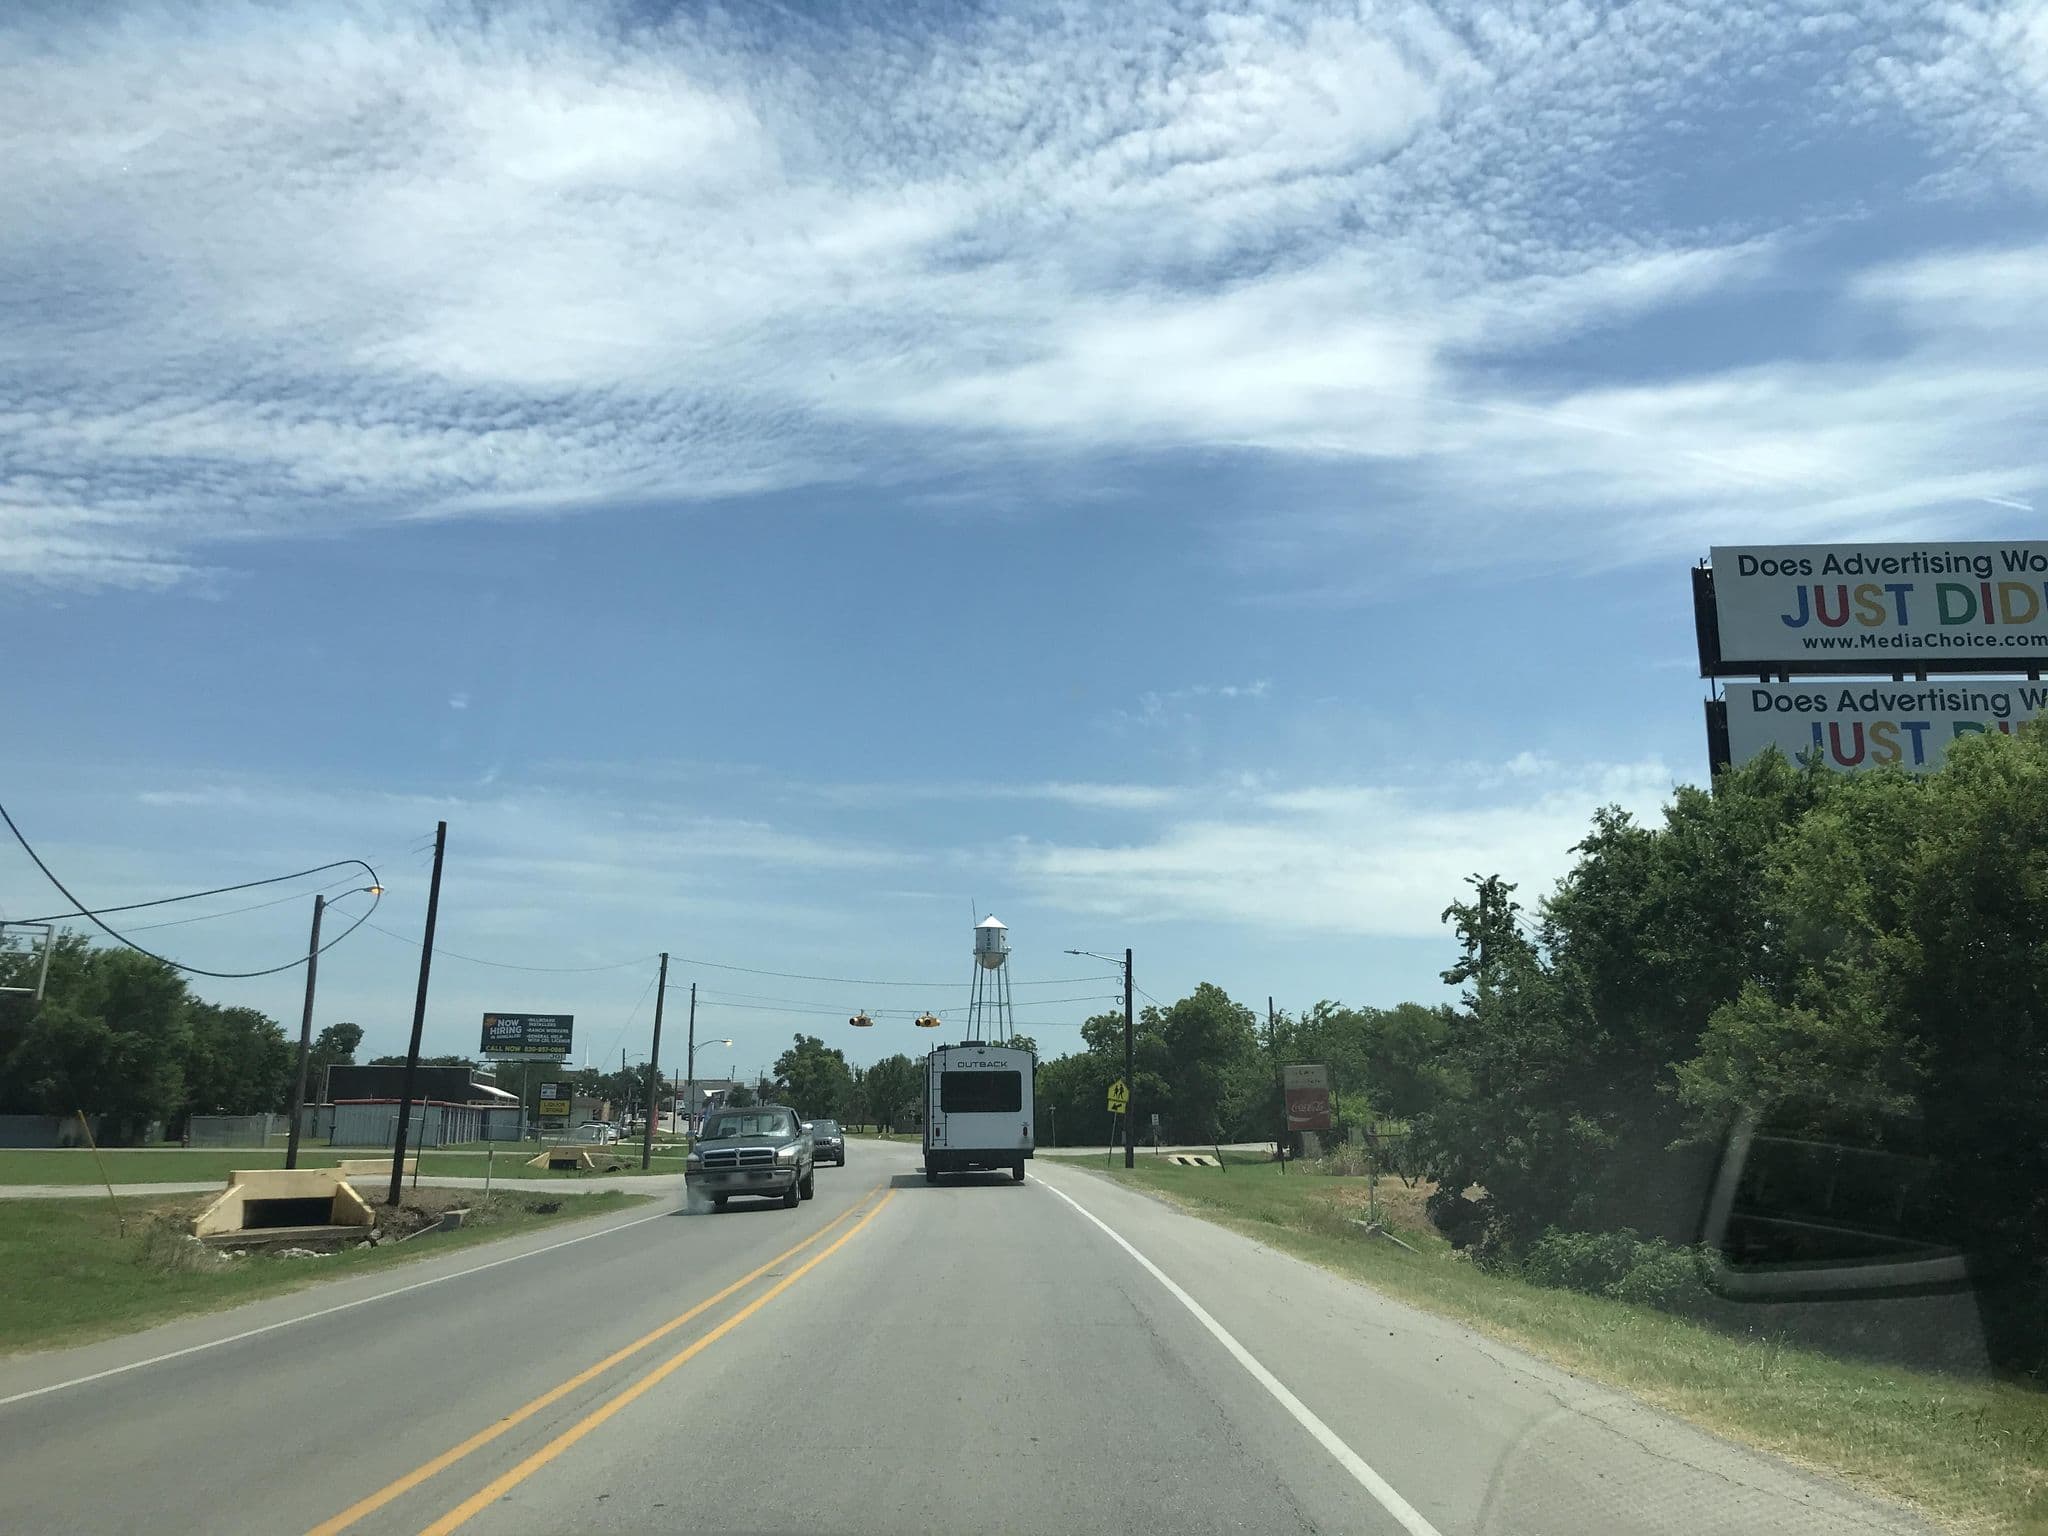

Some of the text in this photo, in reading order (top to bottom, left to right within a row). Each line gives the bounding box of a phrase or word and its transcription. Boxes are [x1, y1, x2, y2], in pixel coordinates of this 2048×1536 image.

[1738, 554, 1813, 577] Does
[1822, 550, 1993, 579] Advertising
[1781, 583, 1914, 628] JUST
[1803, 632, 2048, 649] www.MediaChoice.com
[1752, 689, 1828, 713] Does
[1837, 687, 2010, 718] Advertising
[1795, 720, 1930, 767] JUST
[490, 1026, 522, 1035] HIRING
